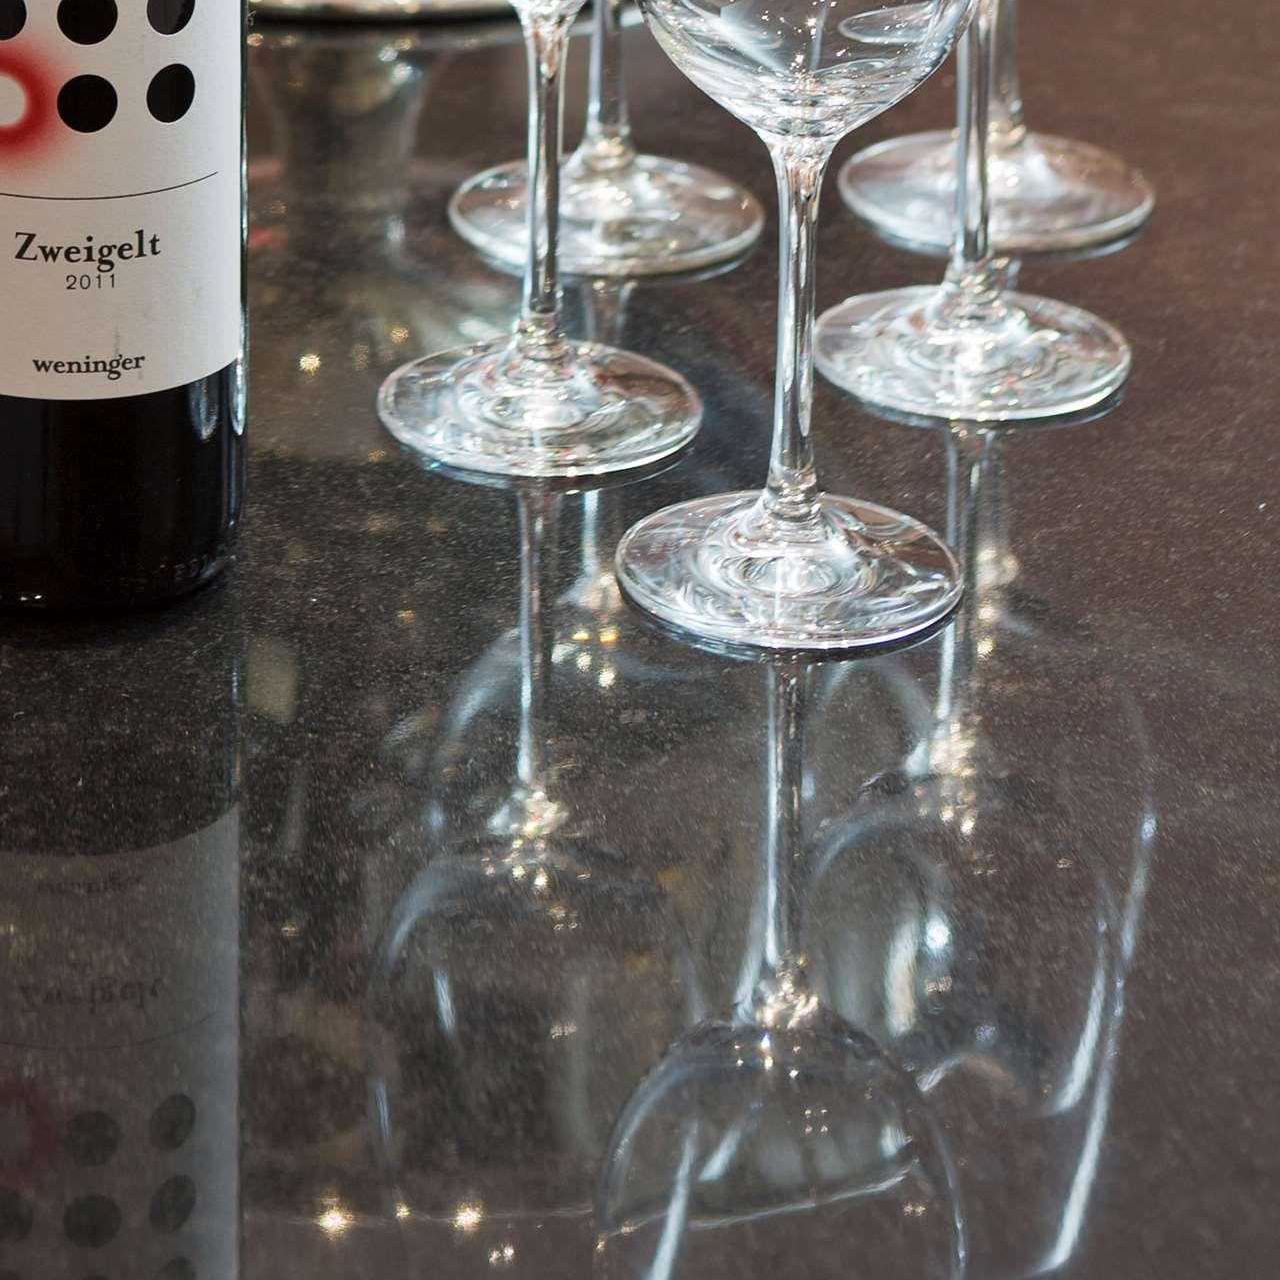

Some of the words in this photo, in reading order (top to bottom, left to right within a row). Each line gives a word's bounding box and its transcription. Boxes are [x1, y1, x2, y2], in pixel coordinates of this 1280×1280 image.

[14, 229, 162, 273] Zweigelt
[65, 273, 116, 290] 2011
[32, 353, 146, 381] weninger
